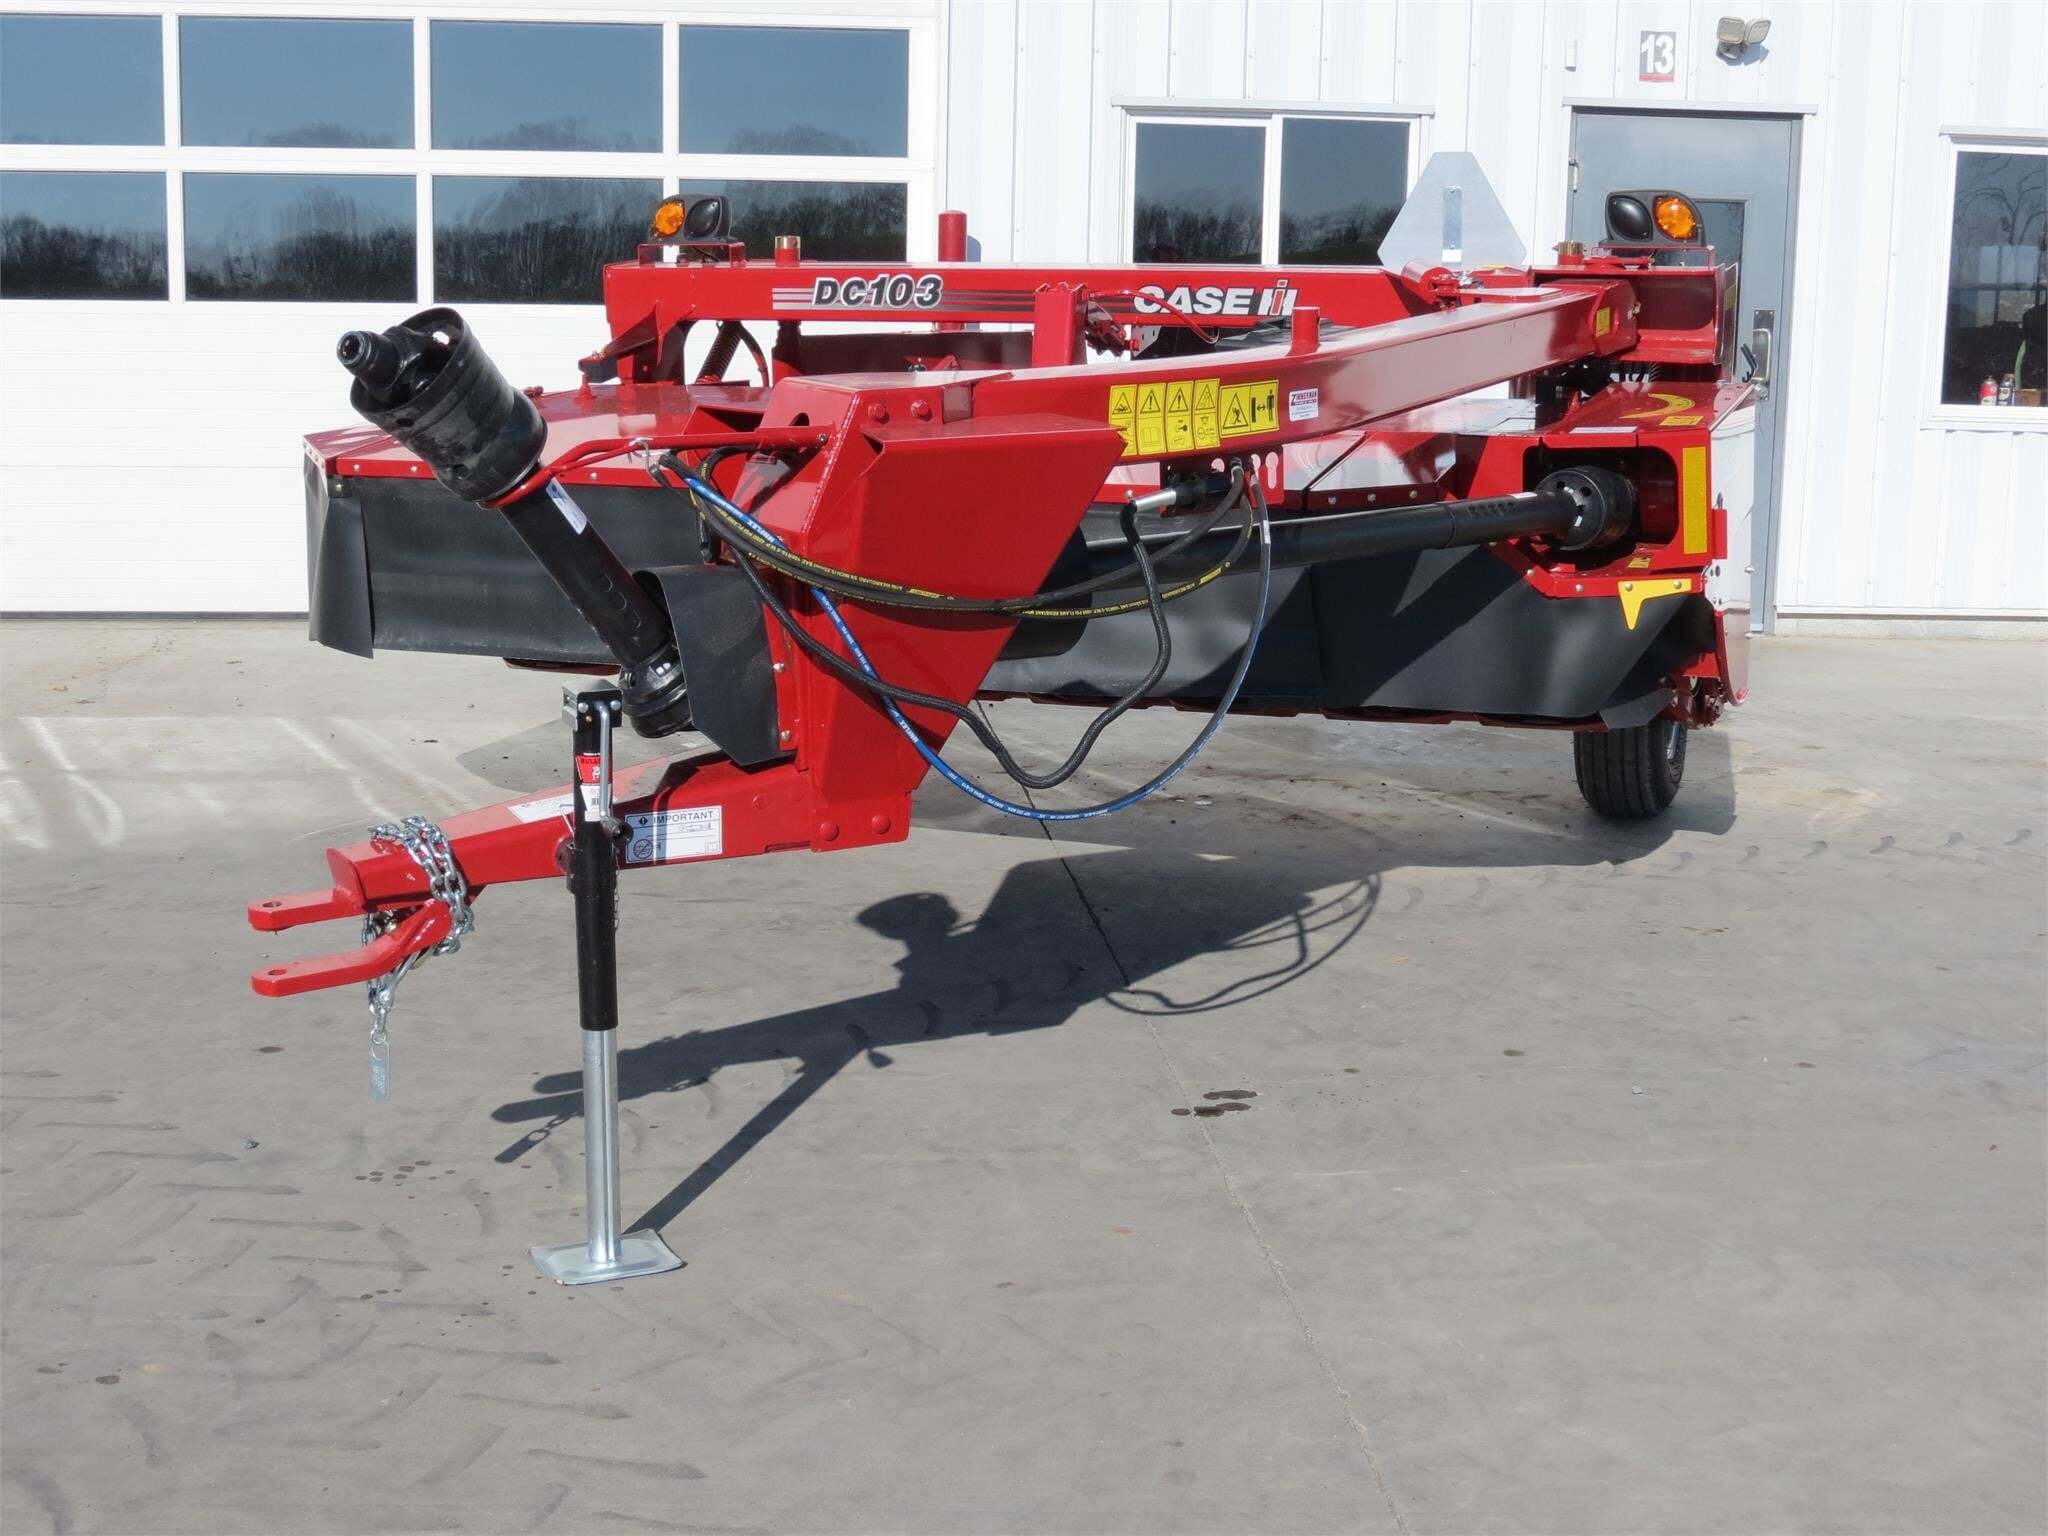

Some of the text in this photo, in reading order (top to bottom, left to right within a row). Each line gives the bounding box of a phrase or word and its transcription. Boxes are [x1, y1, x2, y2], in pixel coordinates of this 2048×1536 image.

[1641, 34, 1674, 74] 13
[812, 274, 943, 308] DC103
[1133, 286, 1254, 315] CASE
[653, 810, 714, 824] IMPORTANT
